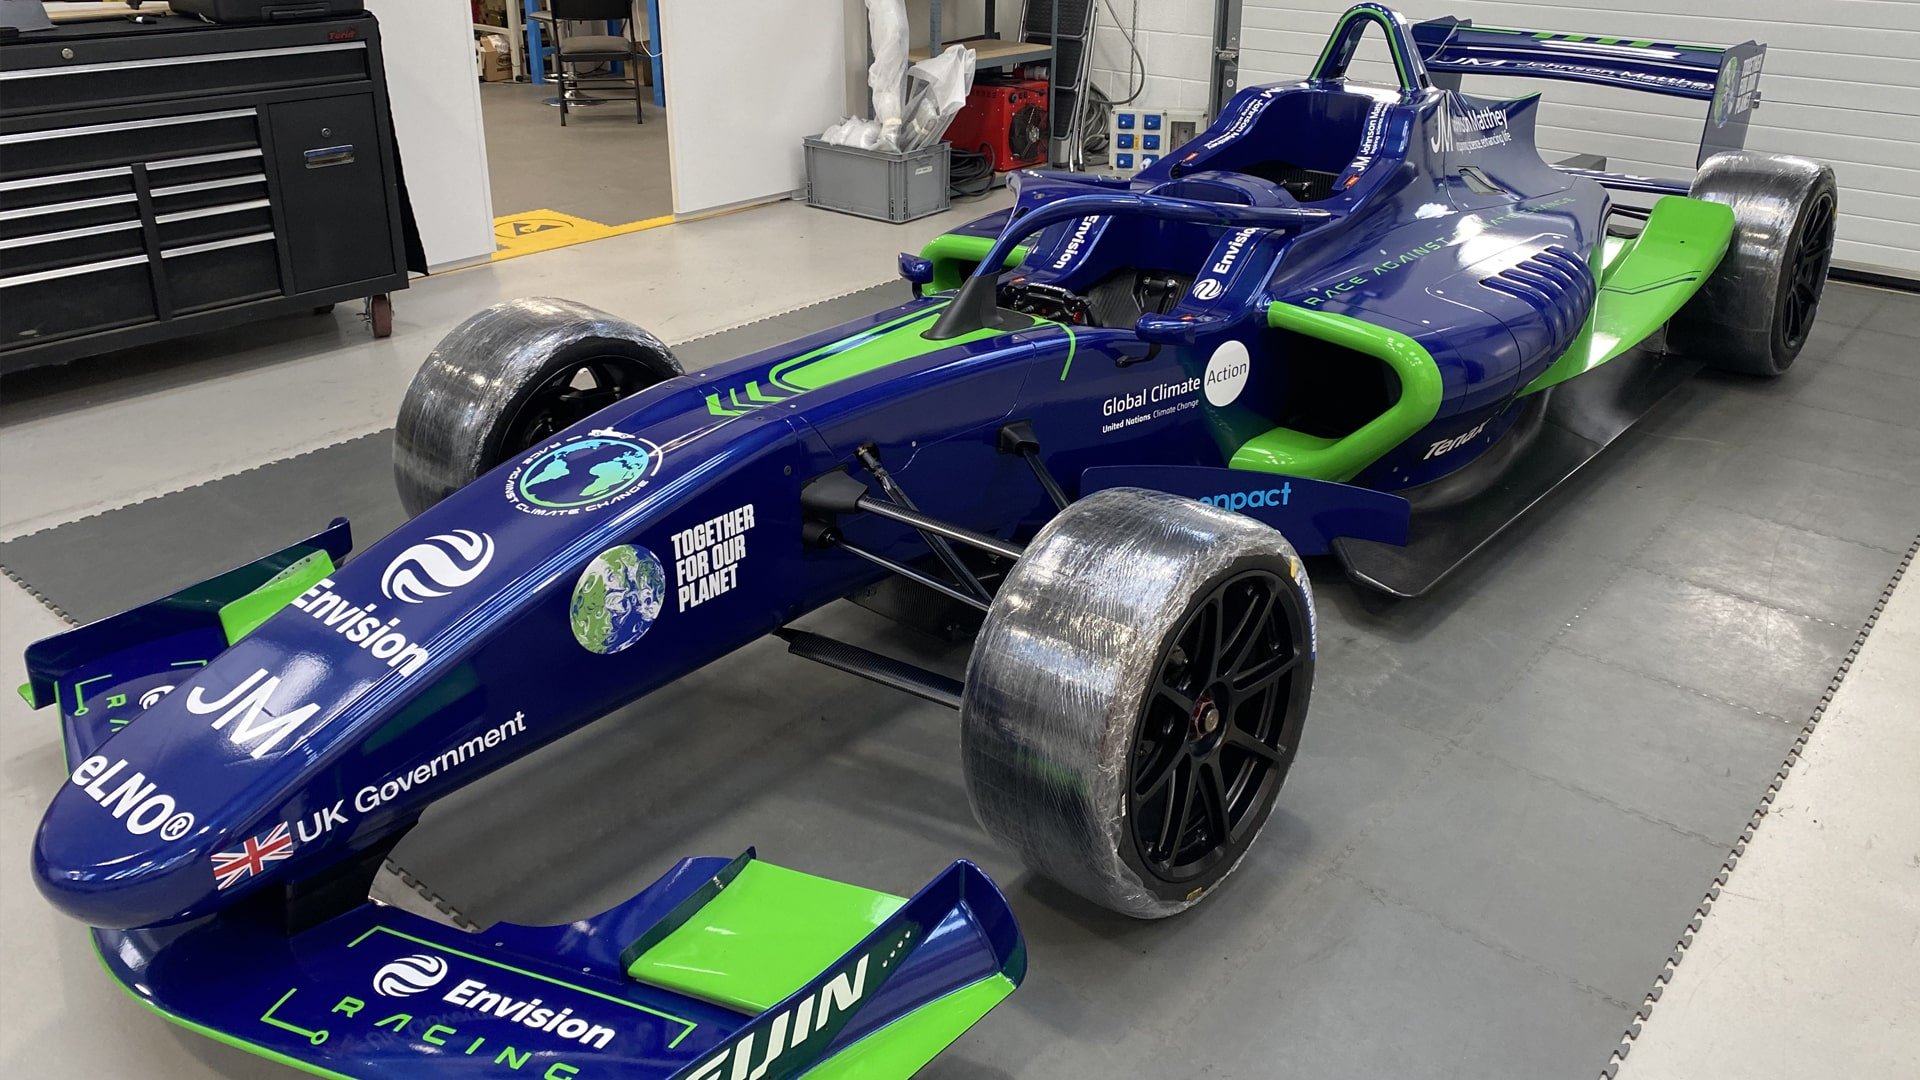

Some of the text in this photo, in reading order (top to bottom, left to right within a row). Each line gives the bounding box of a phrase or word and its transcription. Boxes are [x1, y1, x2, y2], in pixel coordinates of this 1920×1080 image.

[1360, 120, 1377, 155] Johnson
[1431, 99, 1454, 154] JM
[1467, 105, 1508, 133] Matthey
[1350, 156, 1372, 172] JM
[1053, 215, 1100, 270] Envision
[1212, 228, 1261, 275] Envisio
[1303, 276, 1368, 306] RACE
[1373, 236, 1452, 276] AGAINST
[1103, 377, 1201, 417] Global Climate
[1206, 362, 1247, 387] Action
[1102, 398, 1200, 434] United Nations Climate Change
[504, 442, 650, 516] RACE AGAINST CLIMATE CHANGE
[671, 503, 755, 560] TOGETHER
[676, 534, 746, 587] FOR OUR
[678, 562, 738, 613] PLANET
[291, 578, 429, 677] Envision
[186, 668, 321, 760] JM
[296, 710, 527, 843] UK Government
[331, 996, 581, 1080] RACING
[442, 979, 616, 1049] Envision
